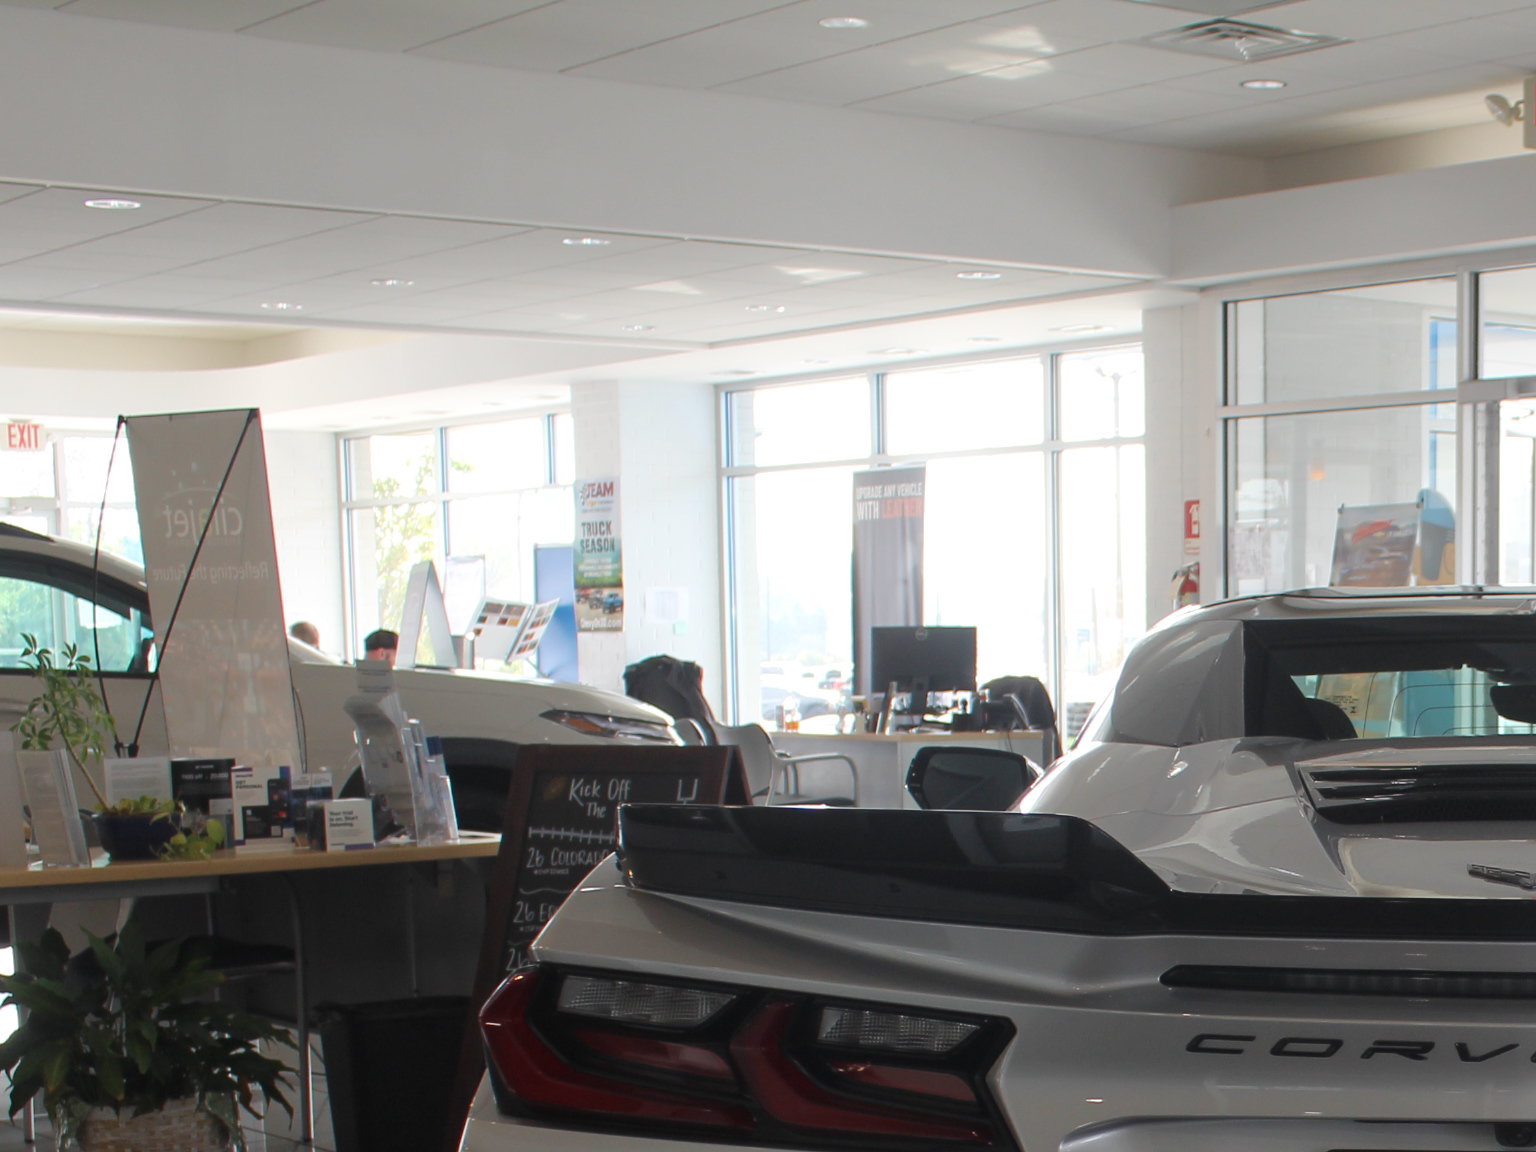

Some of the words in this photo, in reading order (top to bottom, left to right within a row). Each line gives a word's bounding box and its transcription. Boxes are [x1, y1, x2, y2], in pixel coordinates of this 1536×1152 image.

[7, 423, 40, 449] EXIT
[585, 481, 614, 499] TEAM
[884, 484, 896, 497] ANY
[897, 482, 923, 497] VEHICLE
[856, 500, 880, 521] WITH
[581, 520, 612, 537] TRUCK
[580, 537, 616, 555] SEASON
[568, 776, 602, 807] Kick
[608, 777, 632, 801] Off
[586, 801, 607, 819] The
[526, 846, 544, 868] 26
[513, 900, 535, 923] 26
